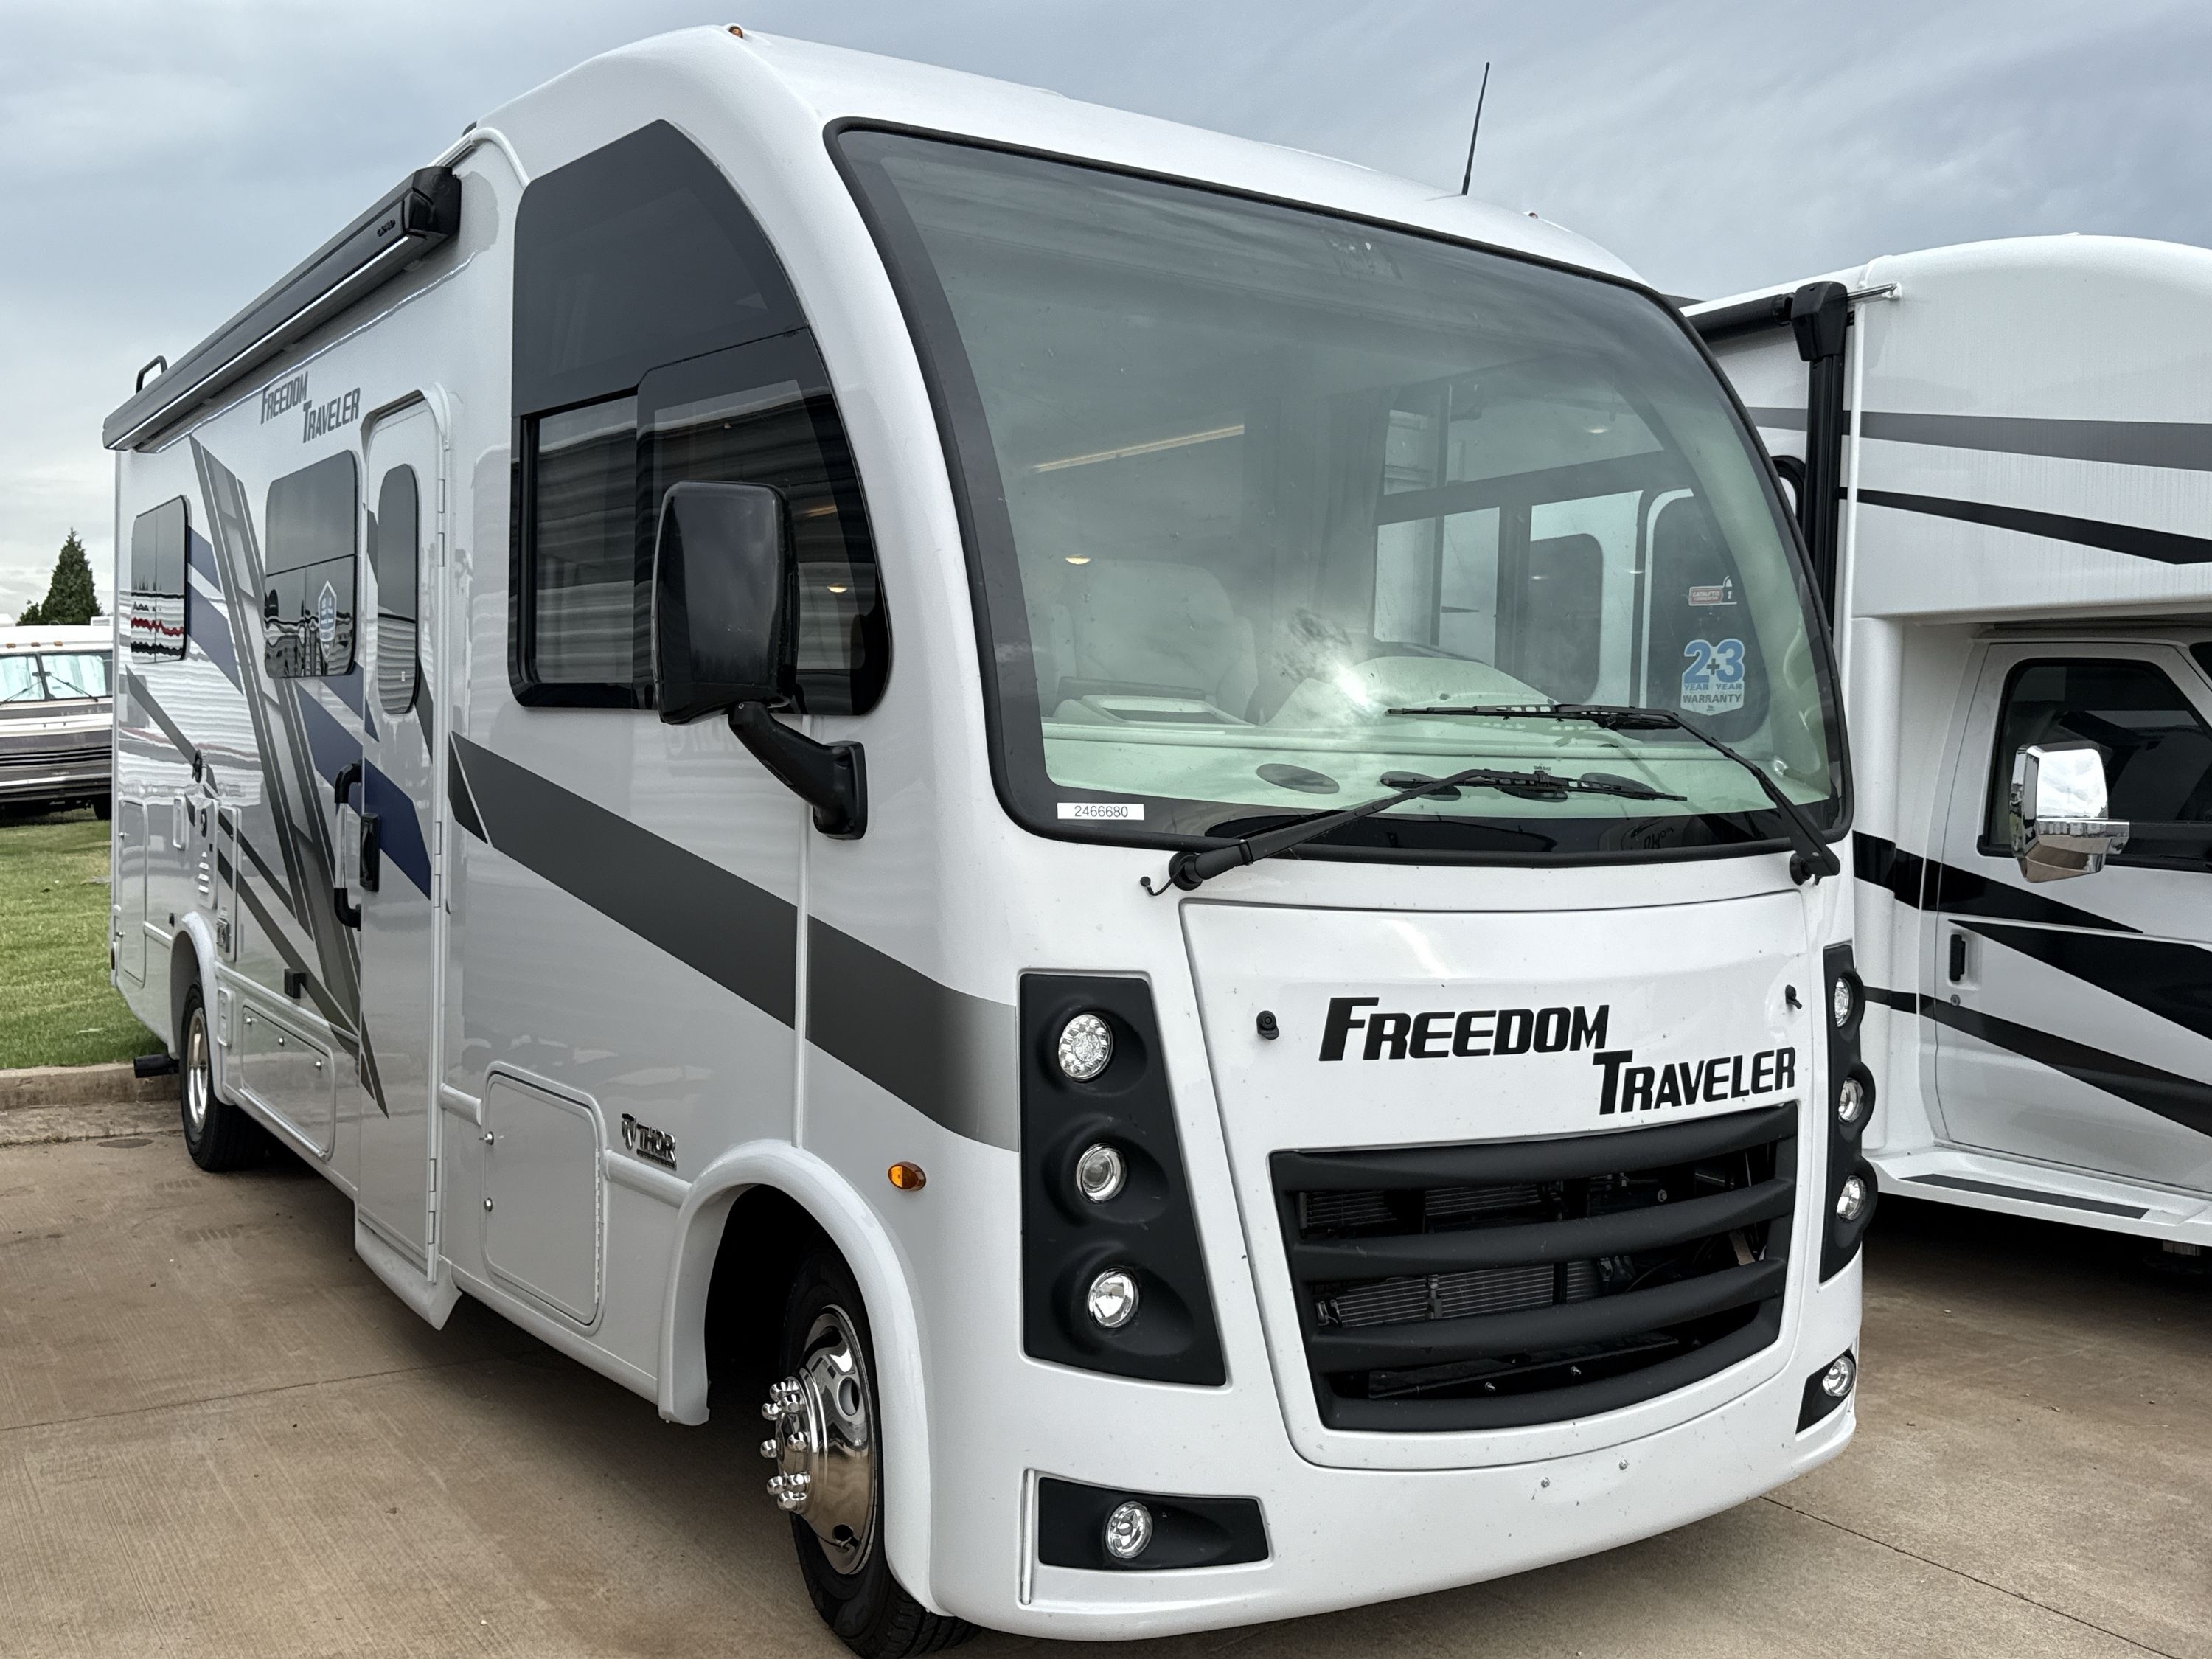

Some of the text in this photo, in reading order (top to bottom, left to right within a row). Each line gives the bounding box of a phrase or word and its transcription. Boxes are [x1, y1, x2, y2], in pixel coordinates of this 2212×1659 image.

[261, 371, 308, 425] FREEDOM
[302, 387, 361, 443] TRAVELER
[1683, 694, 1742, 703] WARRANTY
[1074, 805, 1128, 818] 2466680
[1319, 997, 1610, 1061] FREEDOM
[1593, 1047, 1795, 1115] TRAVELER
[637, 1123, 676, 1163] THOR
